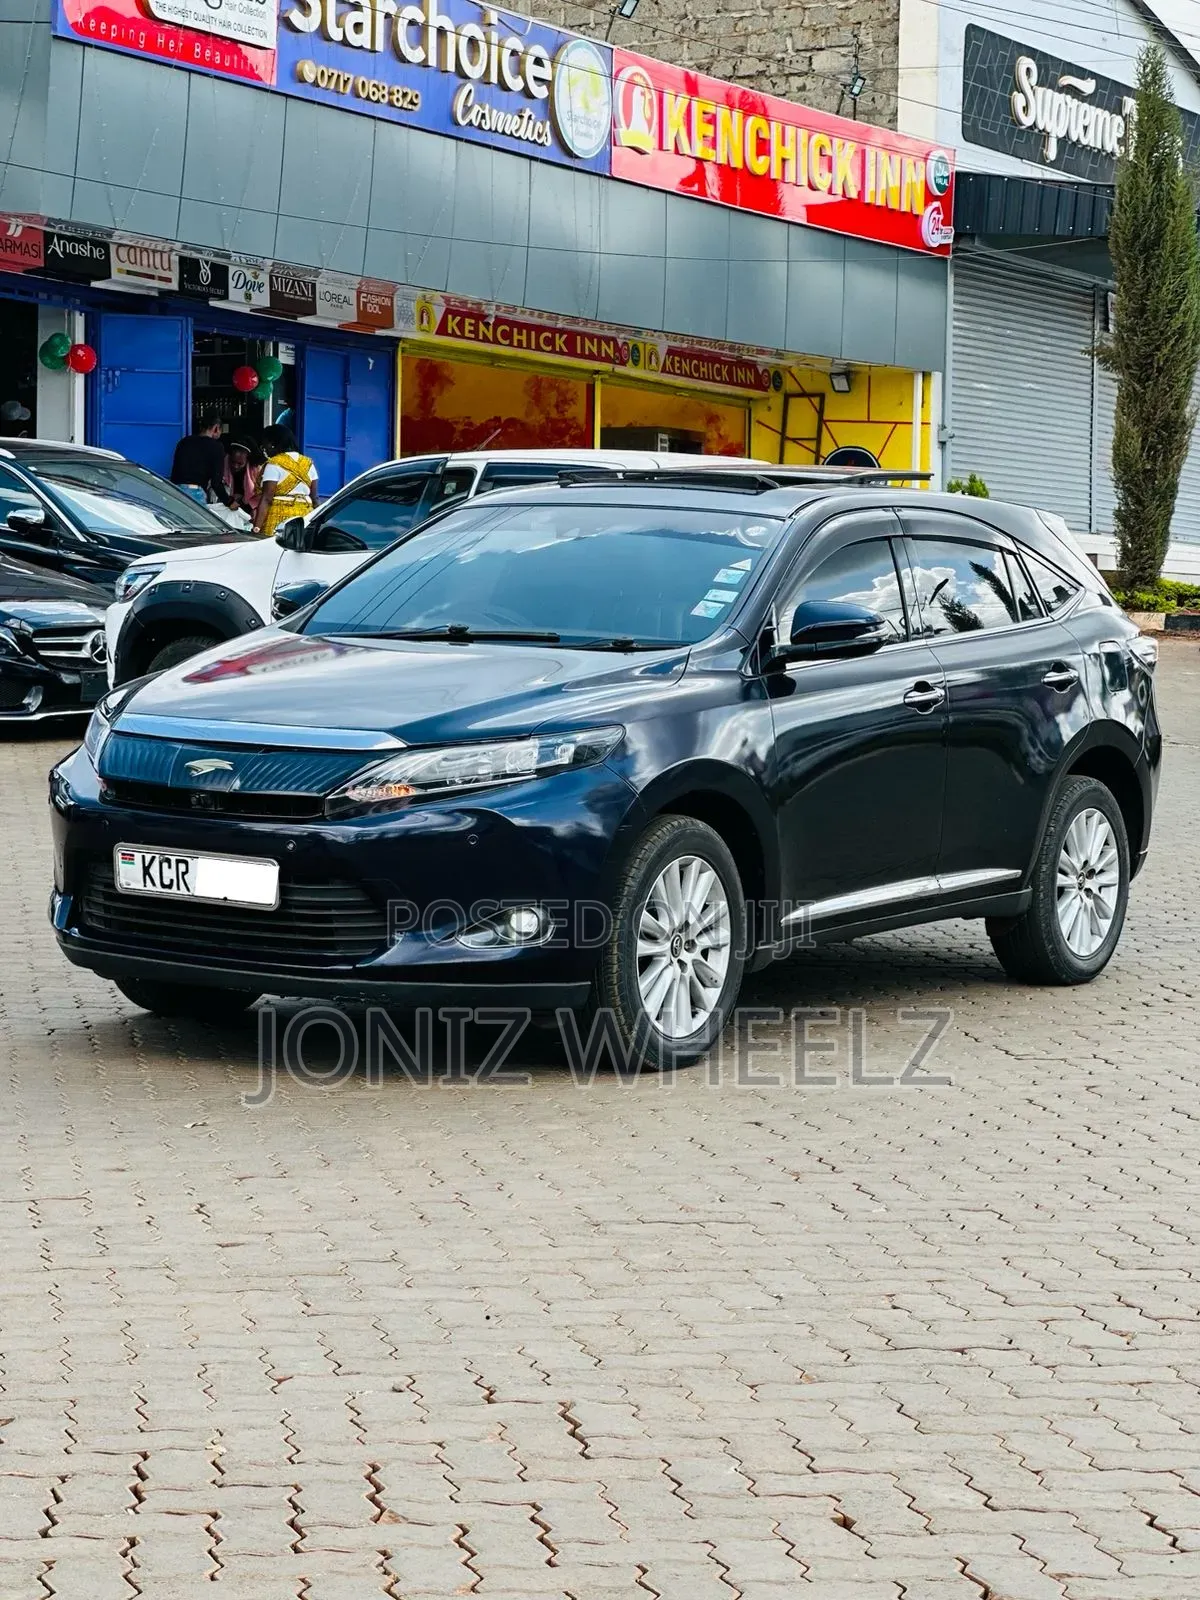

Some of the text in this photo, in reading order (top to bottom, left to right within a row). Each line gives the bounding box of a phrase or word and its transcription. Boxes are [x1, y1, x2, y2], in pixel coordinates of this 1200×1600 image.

[155, 1, 167, 11] THE
[167, 4, 192, 18] HIGHEST
[193, 10, 218, 25] QUALITY
[218, 19, 232, 31] HAIR
[232, 22, 268, 39] COLLECTION
[238, 2, 267, 19] Collection
[77, 13, 146, 49] Keeping
[156, 33, 183, 55] Her
[316, 64, 422, 112] 0717 068 829
[453, 82, 552, 147] Cosmetics
[1011, 55, 1125, 163] Supreme
[662, 88, 925, 216] KENCHICK INN
[48, 233, 105, 260] Anashe
[231, 269, 265, 294] Dove
[271, 276, 313, 298] MIZANI
[360, 292, 392, 312] FASHION
[366, 303, 382, 315] IDOL
[446, 313, 569, 353] KENCHICK
[576, 335, 614, 359] INN
[665, 354, 730, 382] KENCHICK
[732, 366, 756, 385] INN
[141, 854, 191, 893] KCR
